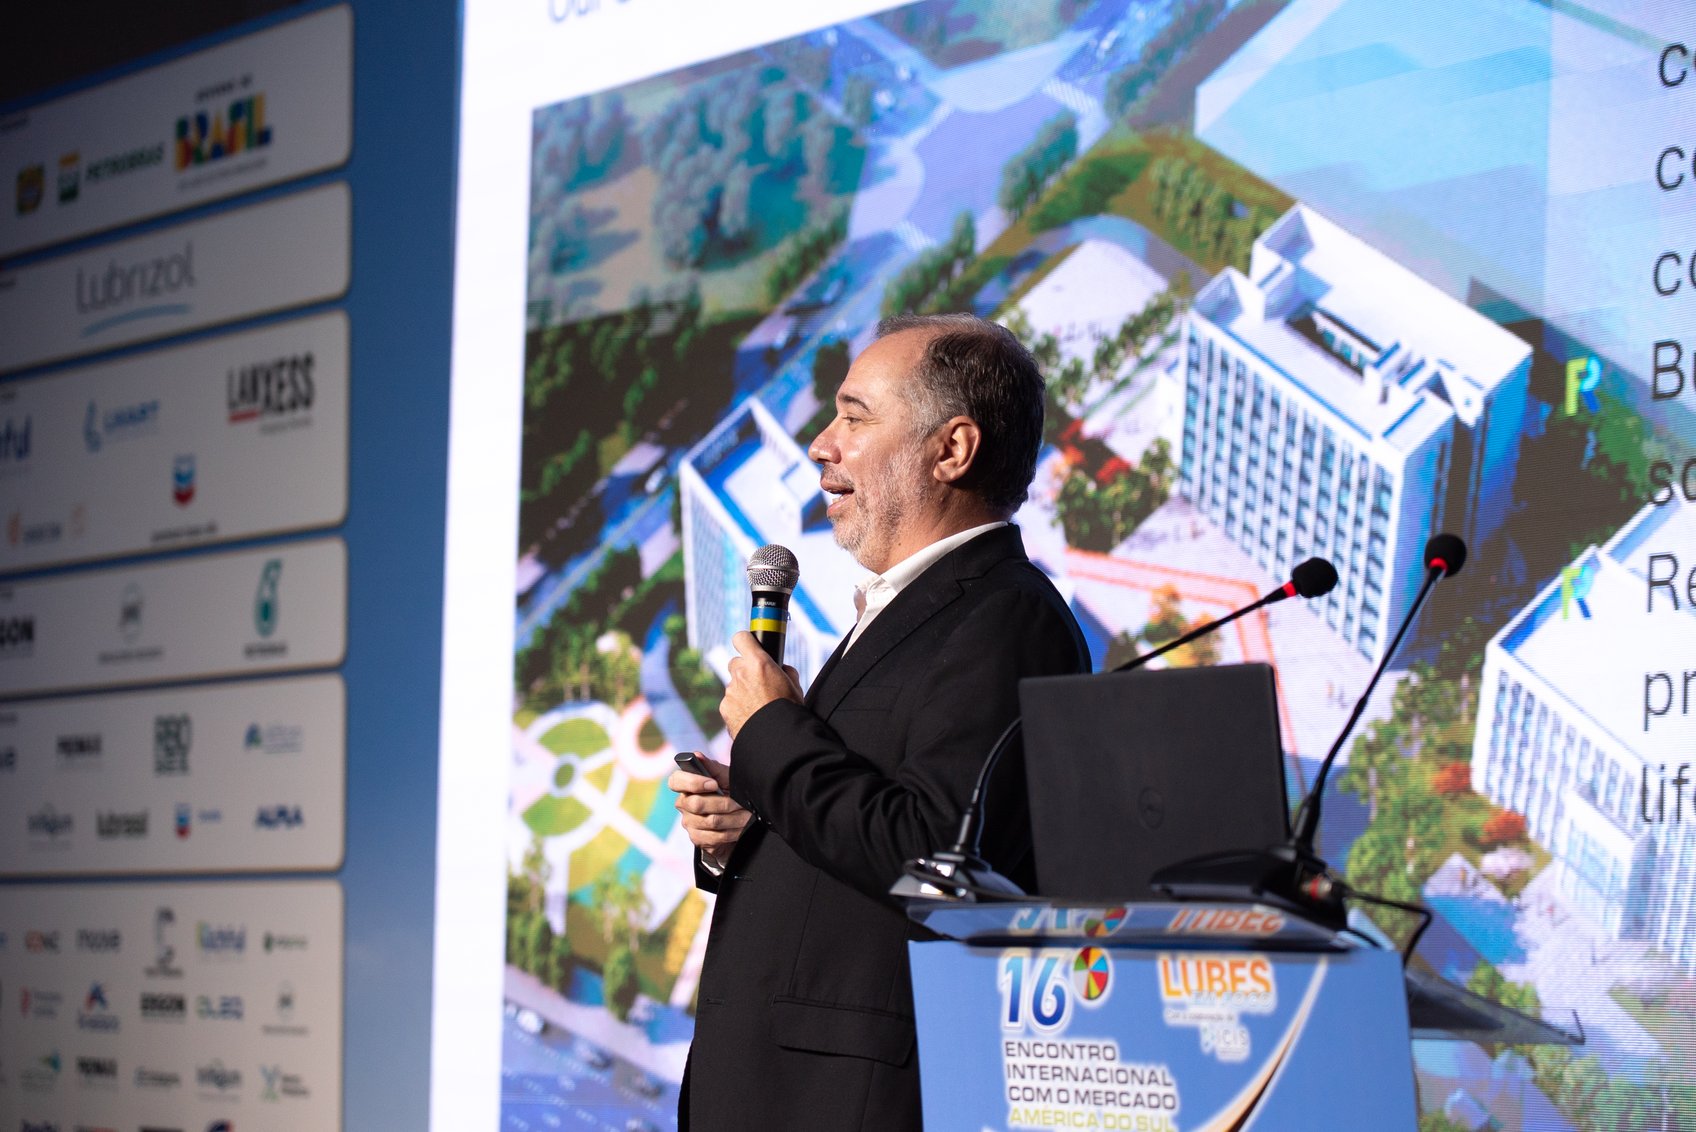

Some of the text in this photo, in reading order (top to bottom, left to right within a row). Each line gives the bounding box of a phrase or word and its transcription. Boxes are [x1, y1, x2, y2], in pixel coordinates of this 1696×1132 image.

[1641, 763, 1696, 824] lif
[1004, 954, 1066, 1027] 16
[1161, 958, 1272, 997] LUBES
[1005, 1041, 1117, 1062] ENCONTRO
[1007, 1063, 1174, 1087] INTERNACIONAL
[1008, 1085, 1177, 1111] COM O MERCADO
[1103, 1113, 1132, 1131] DO
[1136, 1115, 1177, 1132] SUL
